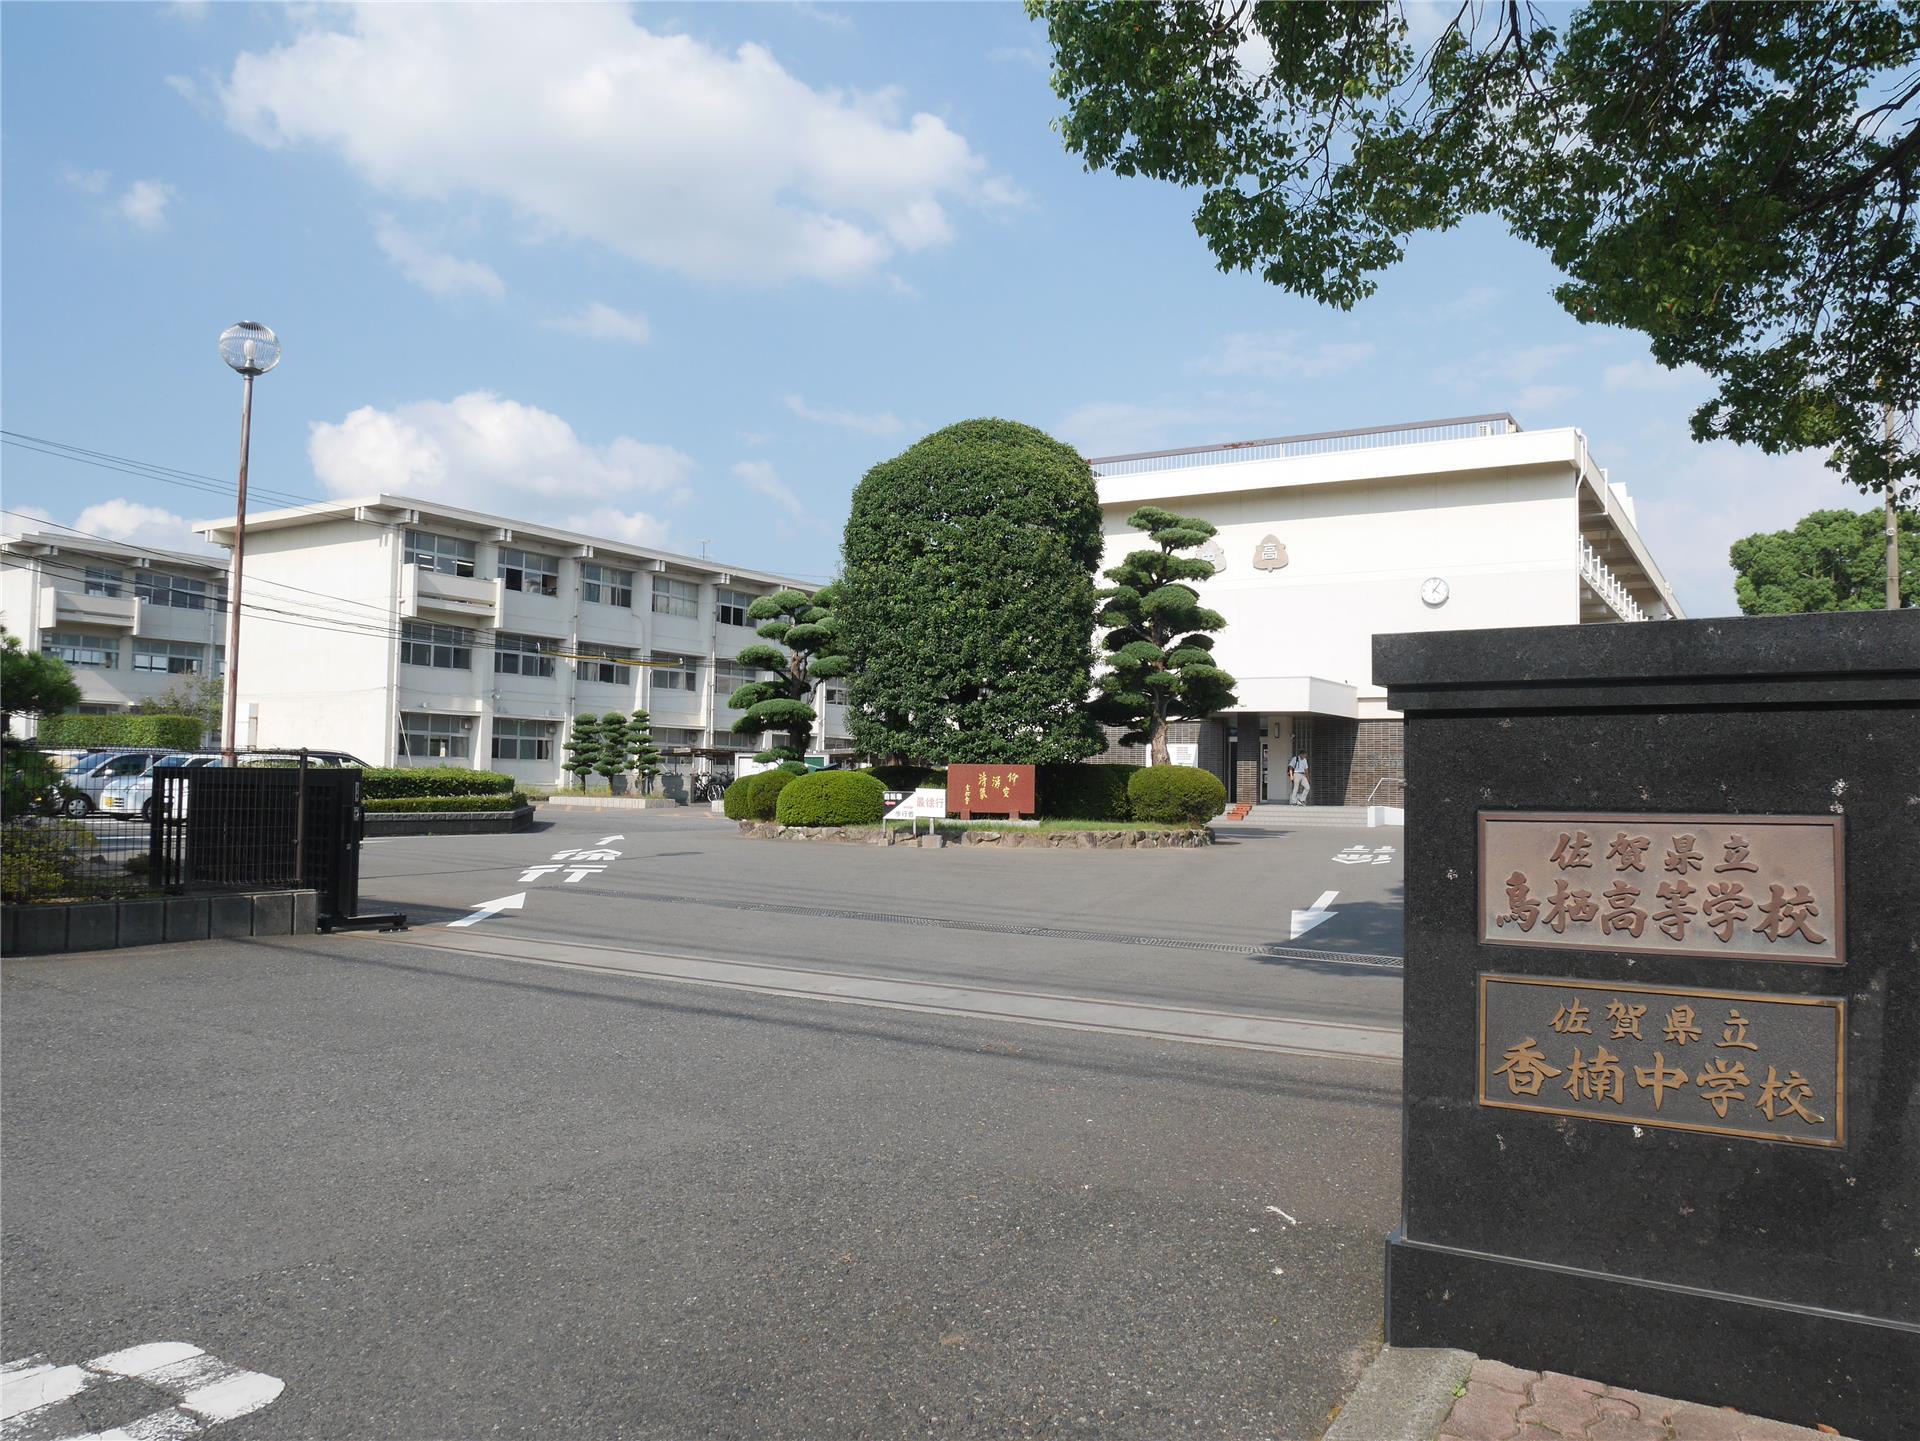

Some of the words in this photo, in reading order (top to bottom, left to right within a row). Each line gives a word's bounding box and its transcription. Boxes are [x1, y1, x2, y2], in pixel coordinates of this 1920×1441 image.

[1262, 543, 1277, 560] 高
[1550, 831, 1759, 875] 佐賀県立
[1496, 871, 1827, 945] 鳥栖高等学校
[1548, 998, 1759, 1052] 佐賀県立
[1494, 1037, 1826, 1125] 香楠中学校
